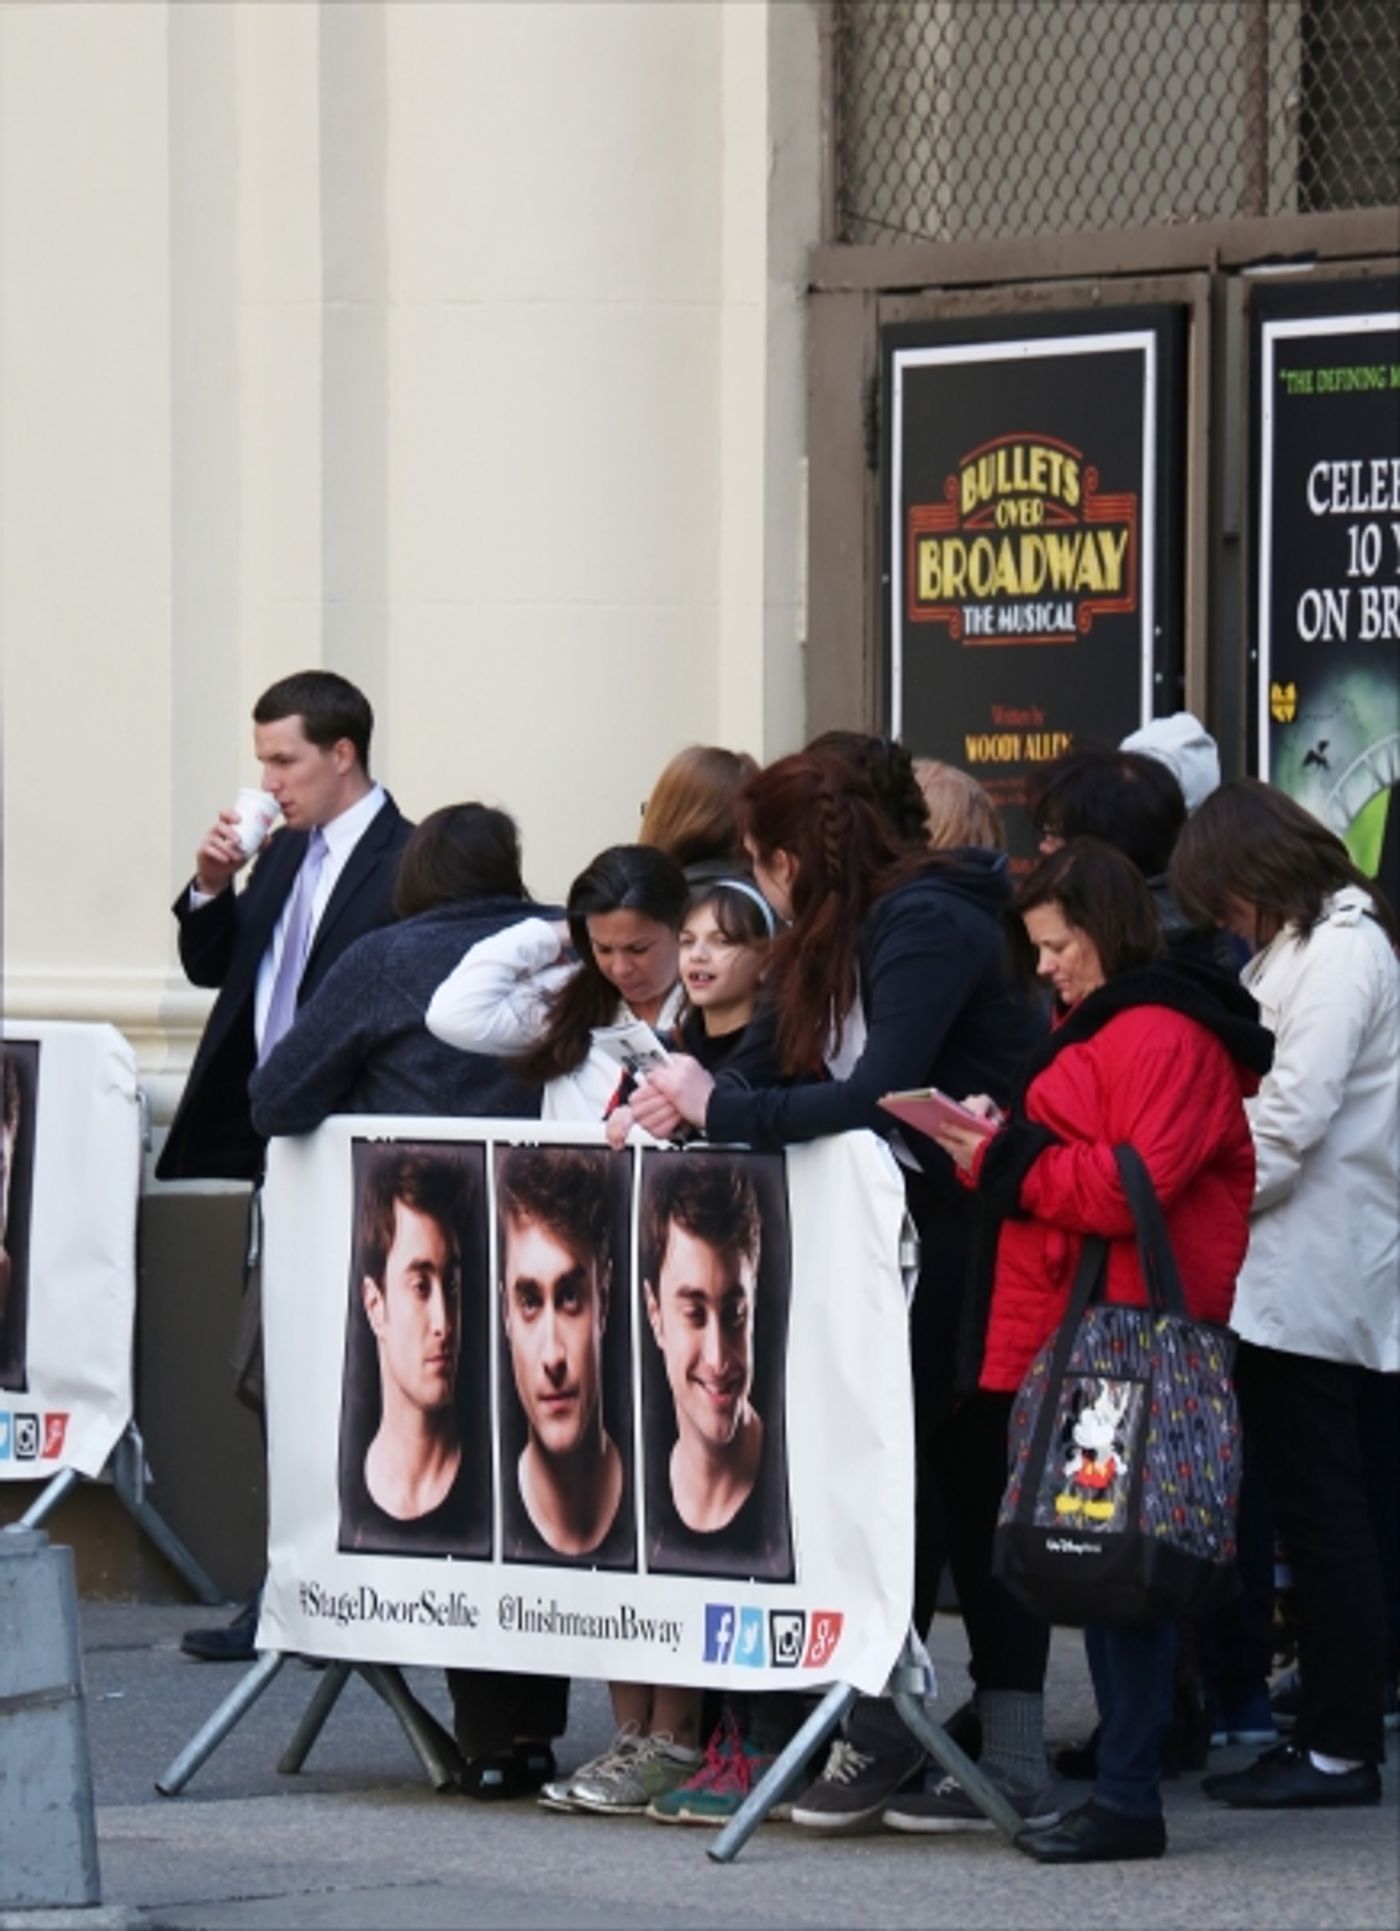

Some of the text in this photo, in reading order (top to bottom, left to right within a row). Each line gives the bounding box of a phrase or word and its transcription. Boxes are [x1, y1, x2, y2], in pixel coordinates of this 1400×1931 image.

[1316, 364, 1386, 394] DEFINING
[961, 445, 1081, 516] BULLETS
[995, 499, 1045, 529] OVER
[918, 529, 1129, 600] BROADWAY
[1346, 522, 1382, 577] 10
[962, 601, 1077, 636] THE MUSICAL
[1296, 588, 1350, 642] ON
[964, 732, 1020, 763] WOODY
